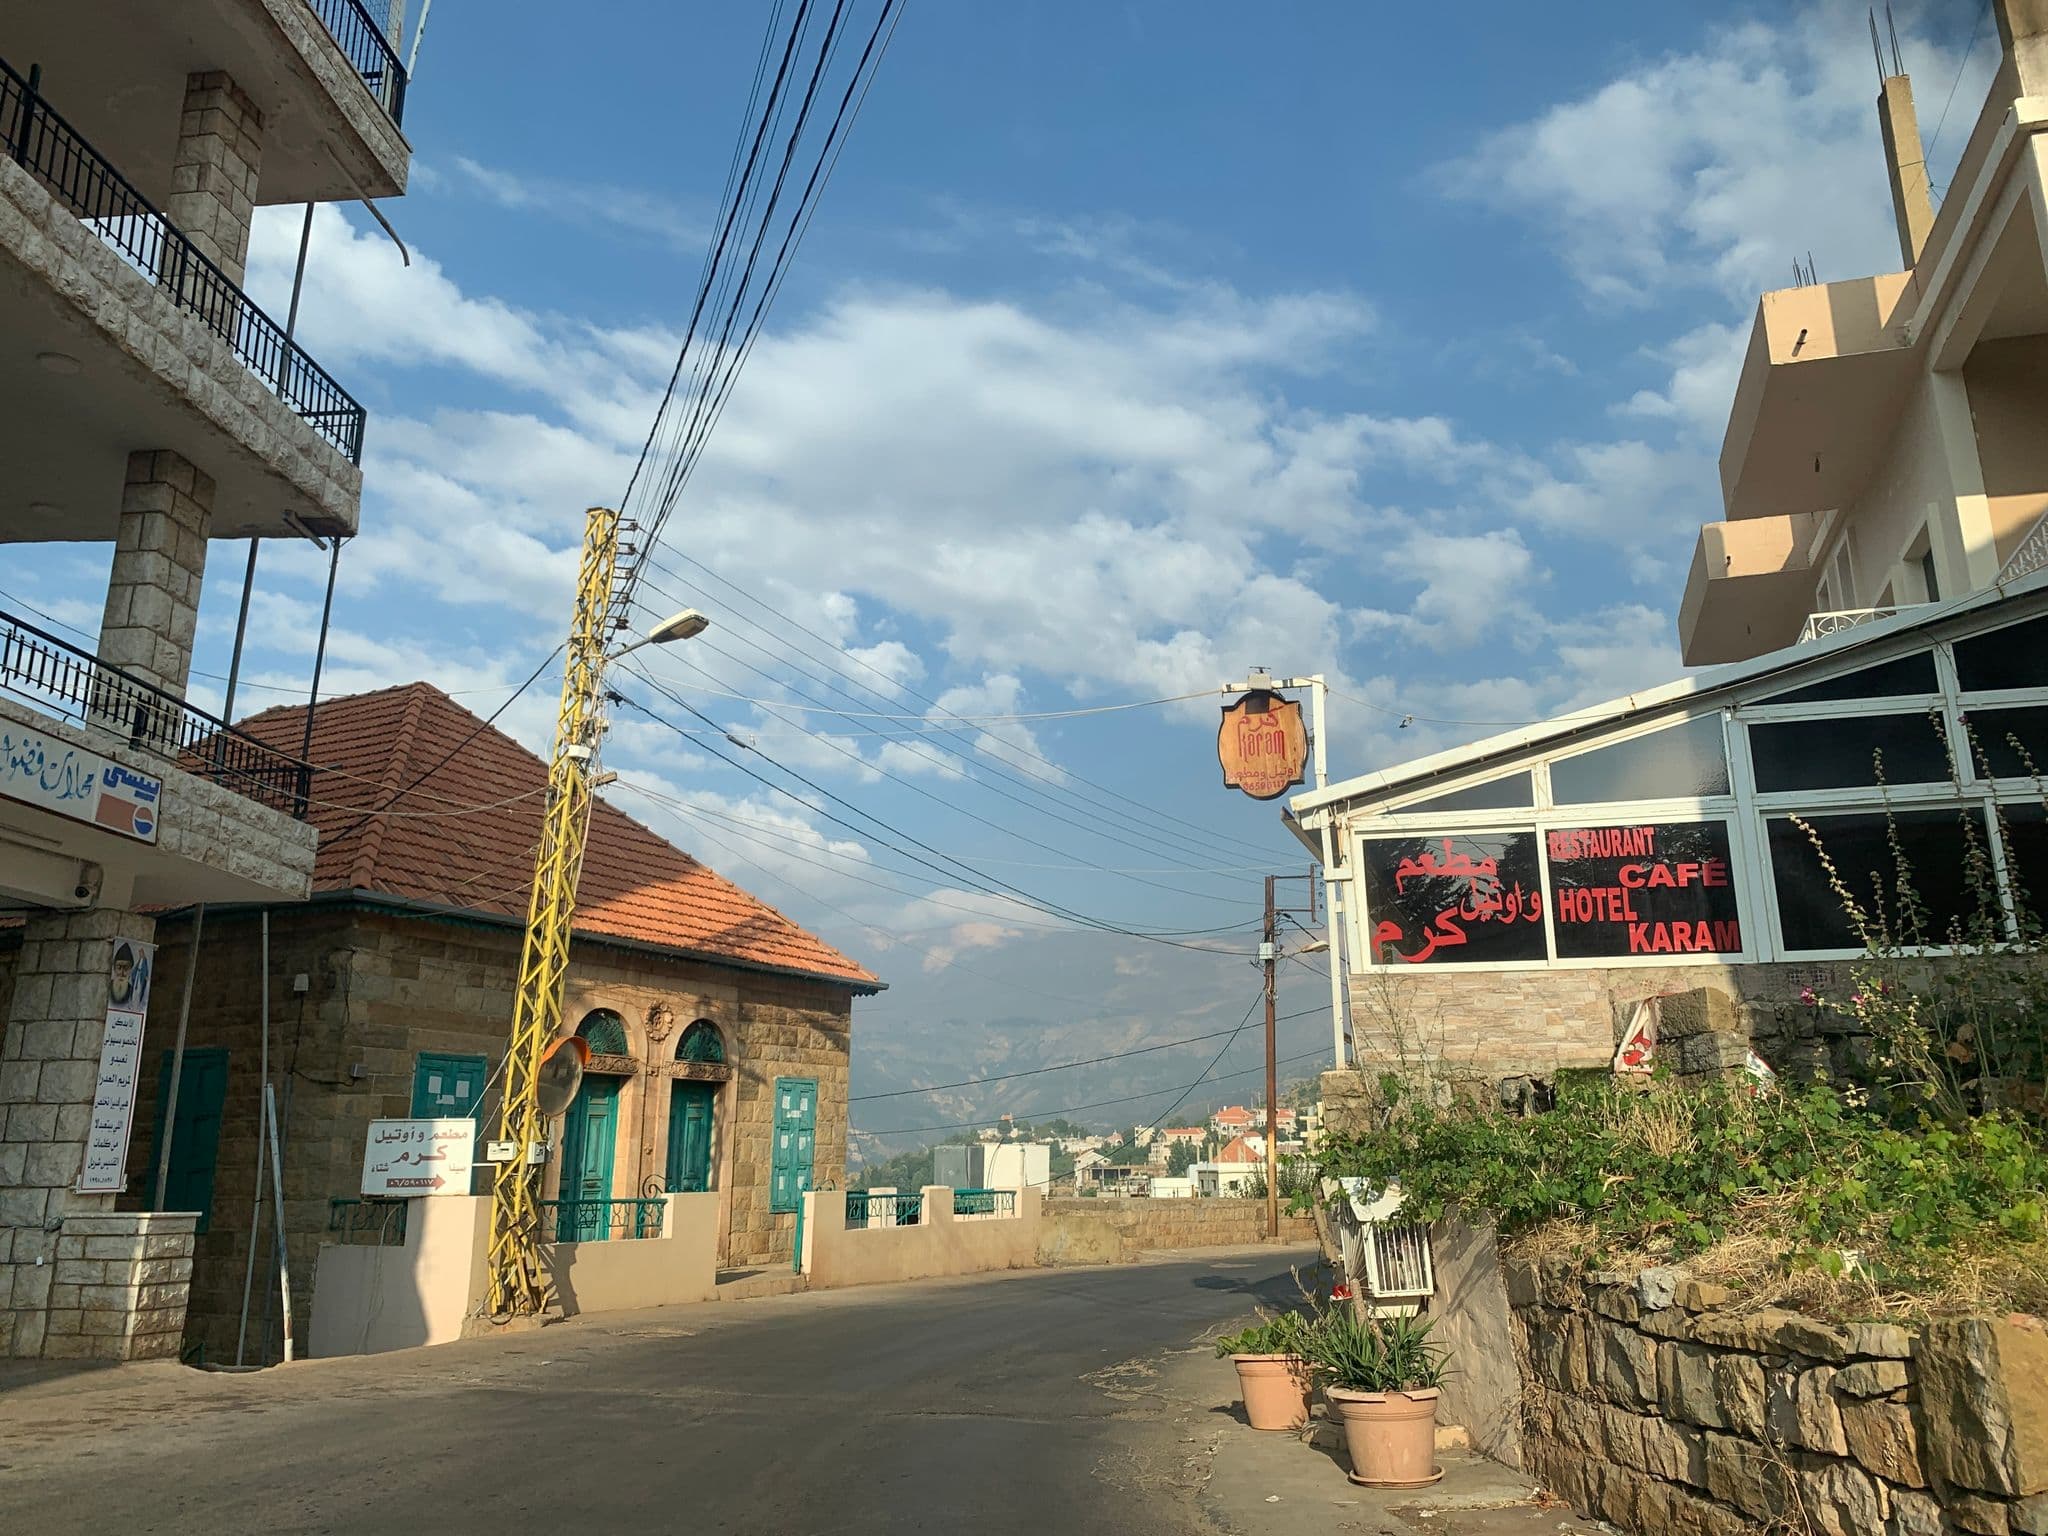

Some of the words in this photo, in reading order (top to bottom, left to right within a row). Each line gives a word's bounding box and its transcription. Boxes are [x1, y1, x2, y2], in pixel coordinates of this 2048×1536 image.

[1549, 827, 1655, 860] RESTAURANT
[1395, 837, 1497, 895] مطعم
[1619, 857, 1728, 888] CAFÉ
[1559, 887, 1638, 922] HOTEL
[1372, 907, 1467, 963] كرم
[1629, 921, 1740, 952] KARAM
[427, 1128, 468, 1141] مطعم
[391, 1145, 448, 1165] كرم
